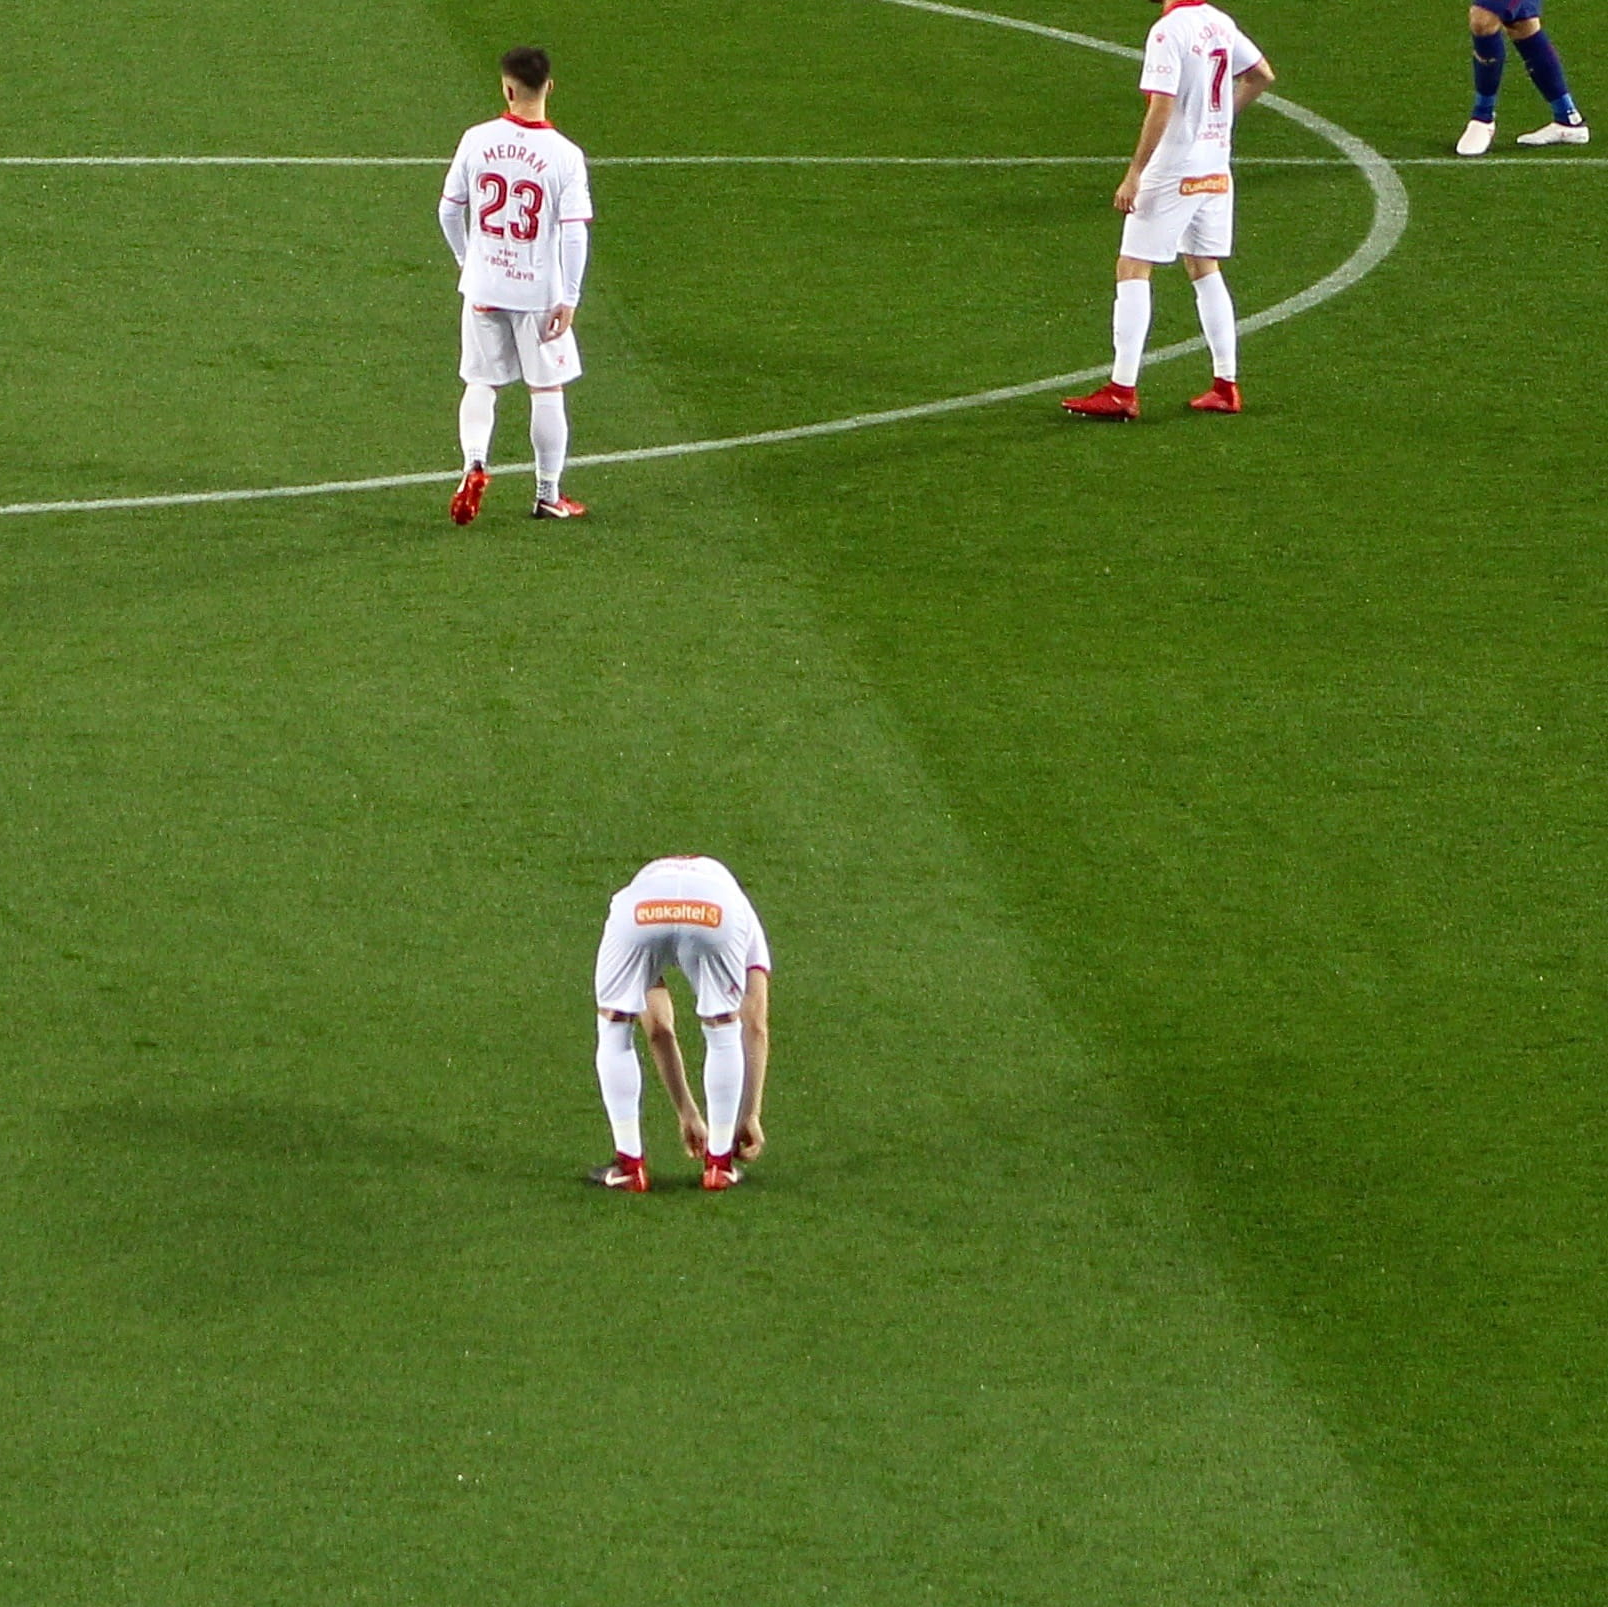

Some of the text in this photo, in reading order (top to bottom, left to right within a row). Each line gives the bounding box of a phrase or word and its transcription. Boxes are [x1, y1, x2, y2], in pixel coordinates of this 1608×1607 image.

[1208, 47, 1229, 113] 7
[476, 172, 545, 243] 23
[637, 903, 705, 921] euskaltel
